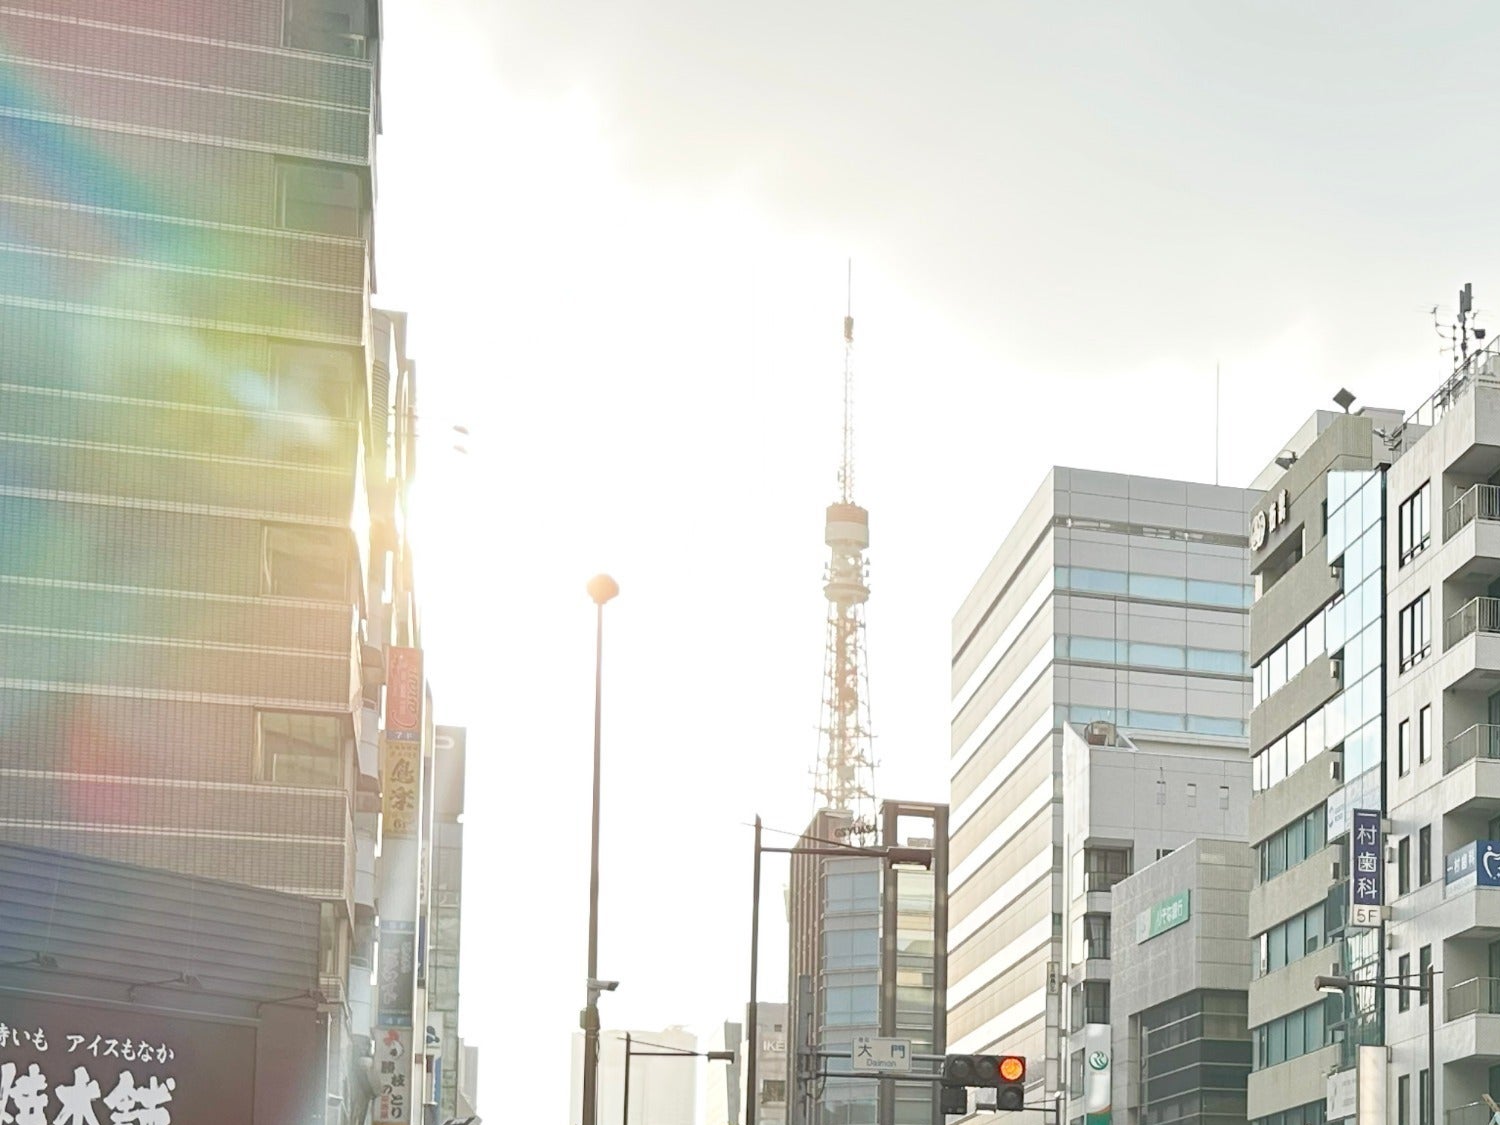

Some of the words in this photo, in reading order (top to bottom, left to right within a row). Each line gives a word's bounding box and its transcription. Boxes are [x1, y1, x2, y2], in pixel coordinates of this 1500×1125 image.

[1357, 812, 1378, 900] 一村歯科
[1446, 850, 1476, 873] 一村歯科
[1356, 909, 1378, 923] 5F
[66, 1034, 175, 1064] アイスもなか
[857, 1043, 906, 1059] 大門
[866, 1058, 897, 1067] Daimon
